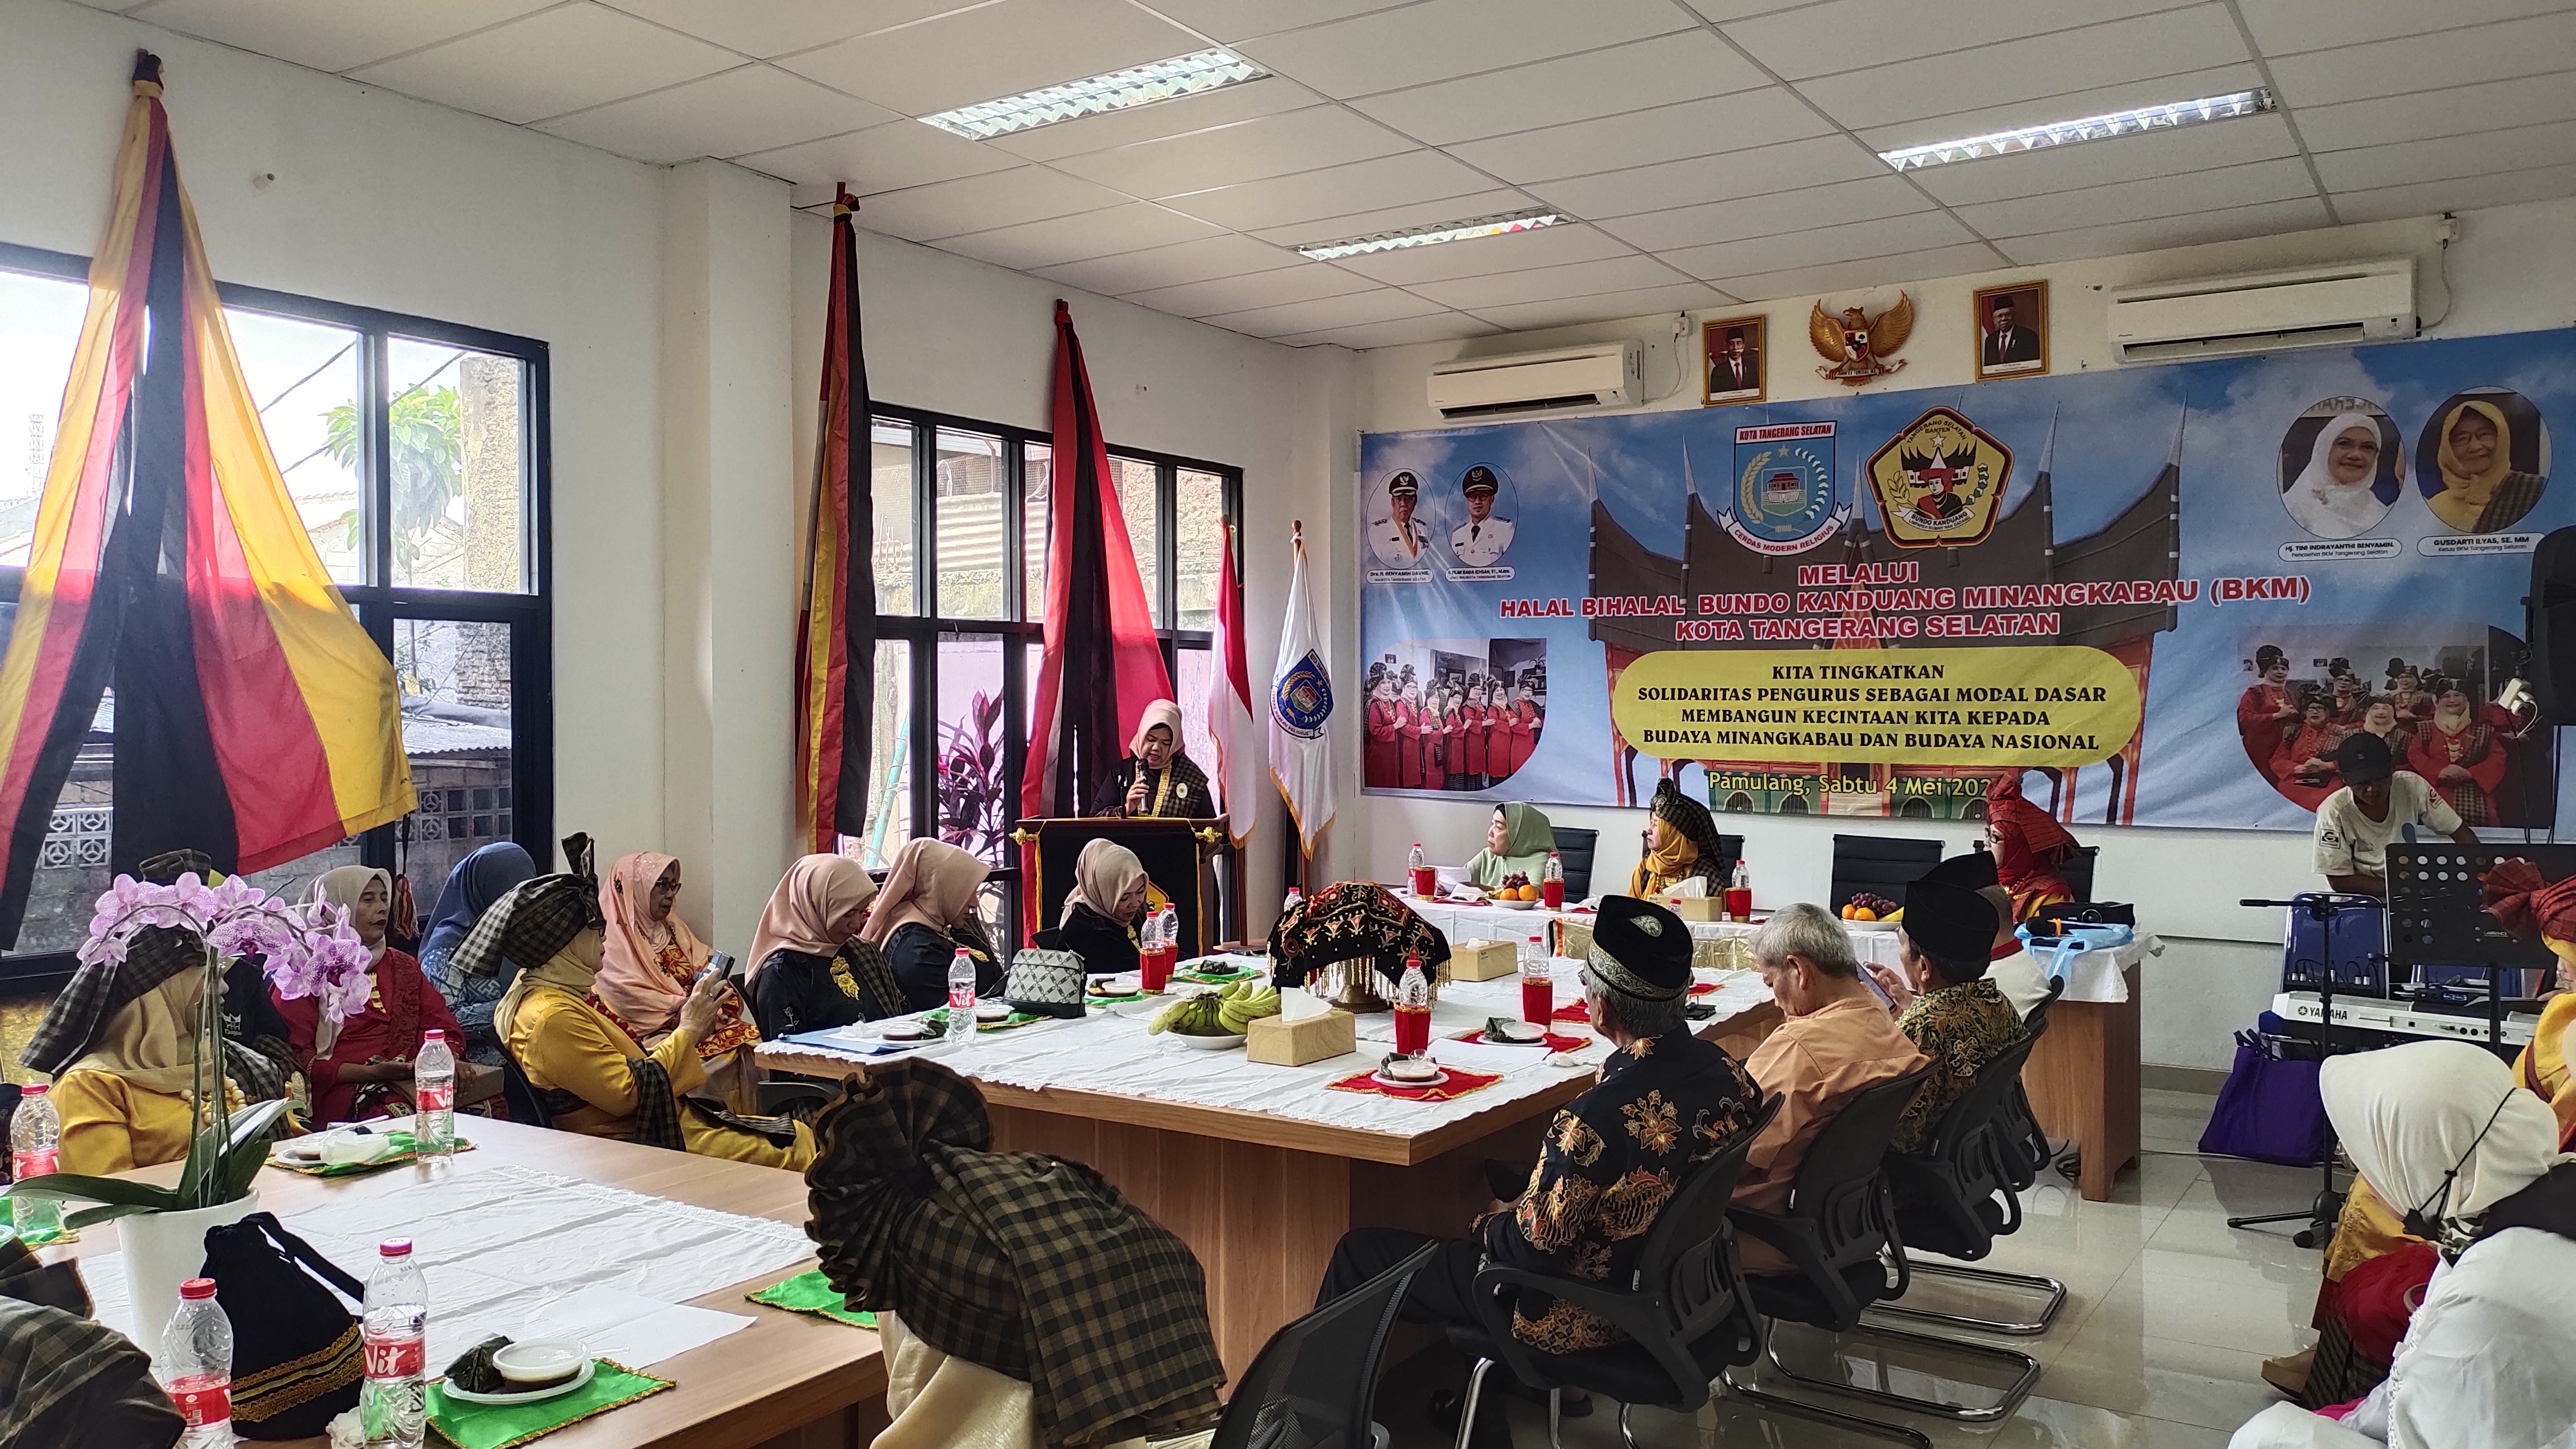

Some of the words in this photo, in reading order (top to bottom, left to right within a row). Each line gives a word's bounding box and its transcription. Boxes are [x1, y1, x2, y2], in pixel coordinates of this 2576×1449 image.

[1740, 431, 1757, 441] KOTA
[1759, 427, 1799, 439] TANGERANG
[1801, 425, 1831, 435] SELATAN
[1907, 420, 1942, 443] TANGERANG
[1943, 420, 1967, 441] SELATAN
[1911, 514, 1932, 525] BUNDO
[1933, 511, 1968, 525] KANDUANG
[1735, 529, 1761, 548] CERDAS
[1763, 543, 1798, 552] MODERN
[1800, 525, 1834, 549] RELIGIUS
[1798, 562, 1918, 585] MELALUI
[1501, 599, 1573, 617] HALAL
[1582, 596, 1685, 615] BIHALAL
[1698, 593, 1789, 614] BUNDO
[1797, 588, 1955, 612] KANDUANG
[1965, 580, 2199, 607] MINANGKABAU
[2210, 576, 2310, 605] (BKM)
[1676, 621, 1742, 641] KOTA
[1750, 617, 1917, 640] TANGERANG
[1925, 613, 2059, 637] SELATAN
[1772, 665, 1814, 680] KITA
[1820, 665, 1944, 680] TINGKATKAN
[1638, 688, 1752, 701] SOLIDARITAS
[1758, 688, 1860, 702] PENGURUS
[1865, 688, 1950, 702] SEBAGAI
[1957, 688, 2029, 702] MODAL
[2035, 687, 2106, 702] DASAR
[1681, 709, 1797, 723] MEMBANGUN
[1802, 710, 1908, 724] KECINTAAN
[1915, 711, 1961, 725] KITA
[1967, 711, 2051, 725] KEPADA
[1644, 730, 1711, 744] BUDAYA
[1717, 731, 1853, 746] MINANGKABAU
[1859, 733, 1898, 747] DAN
[1905, 733, 1985, 749] BUDAYA
[1991, 735, 2099, 750] NASIONAL
[1710, 772, 1810, 796] Pamulang,
[1819, 775, 1877, 794] Sabtu
[1884, 777, 1898, 794] 4
[1904, 778, 1943, 796] Mei
[1951, 778, 1991, 797] 202
[952, 992, 973, 1007] Vit
[434, 1089, 452, 1108] Vi
[364, 1345, 408, 1376] Vit
